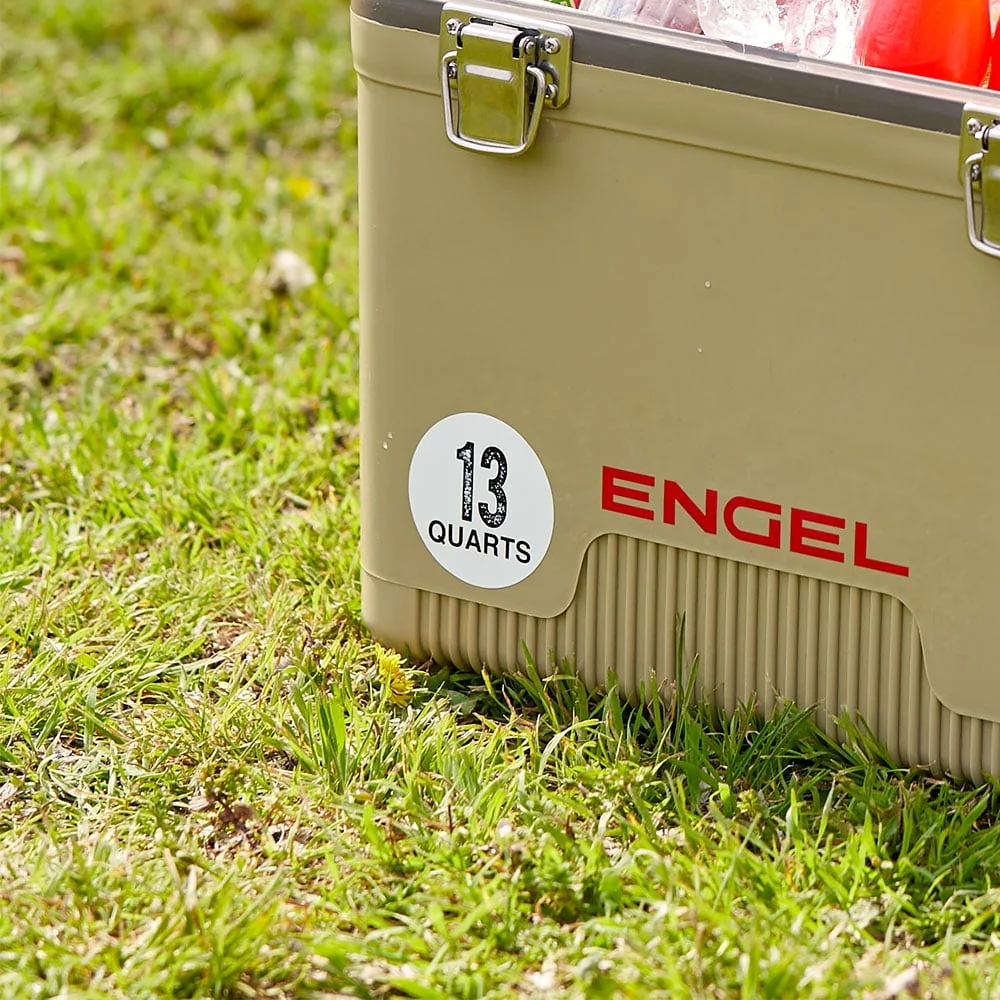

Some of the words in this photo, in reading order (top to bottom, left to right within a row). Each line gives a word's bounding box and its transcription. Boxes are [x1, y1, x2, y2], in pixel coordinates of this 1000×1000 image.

[456, 441, 509, 529] 13
[602, 465, 909, 578] ENGEL
[428, 520, 532, 565] QUARTS
